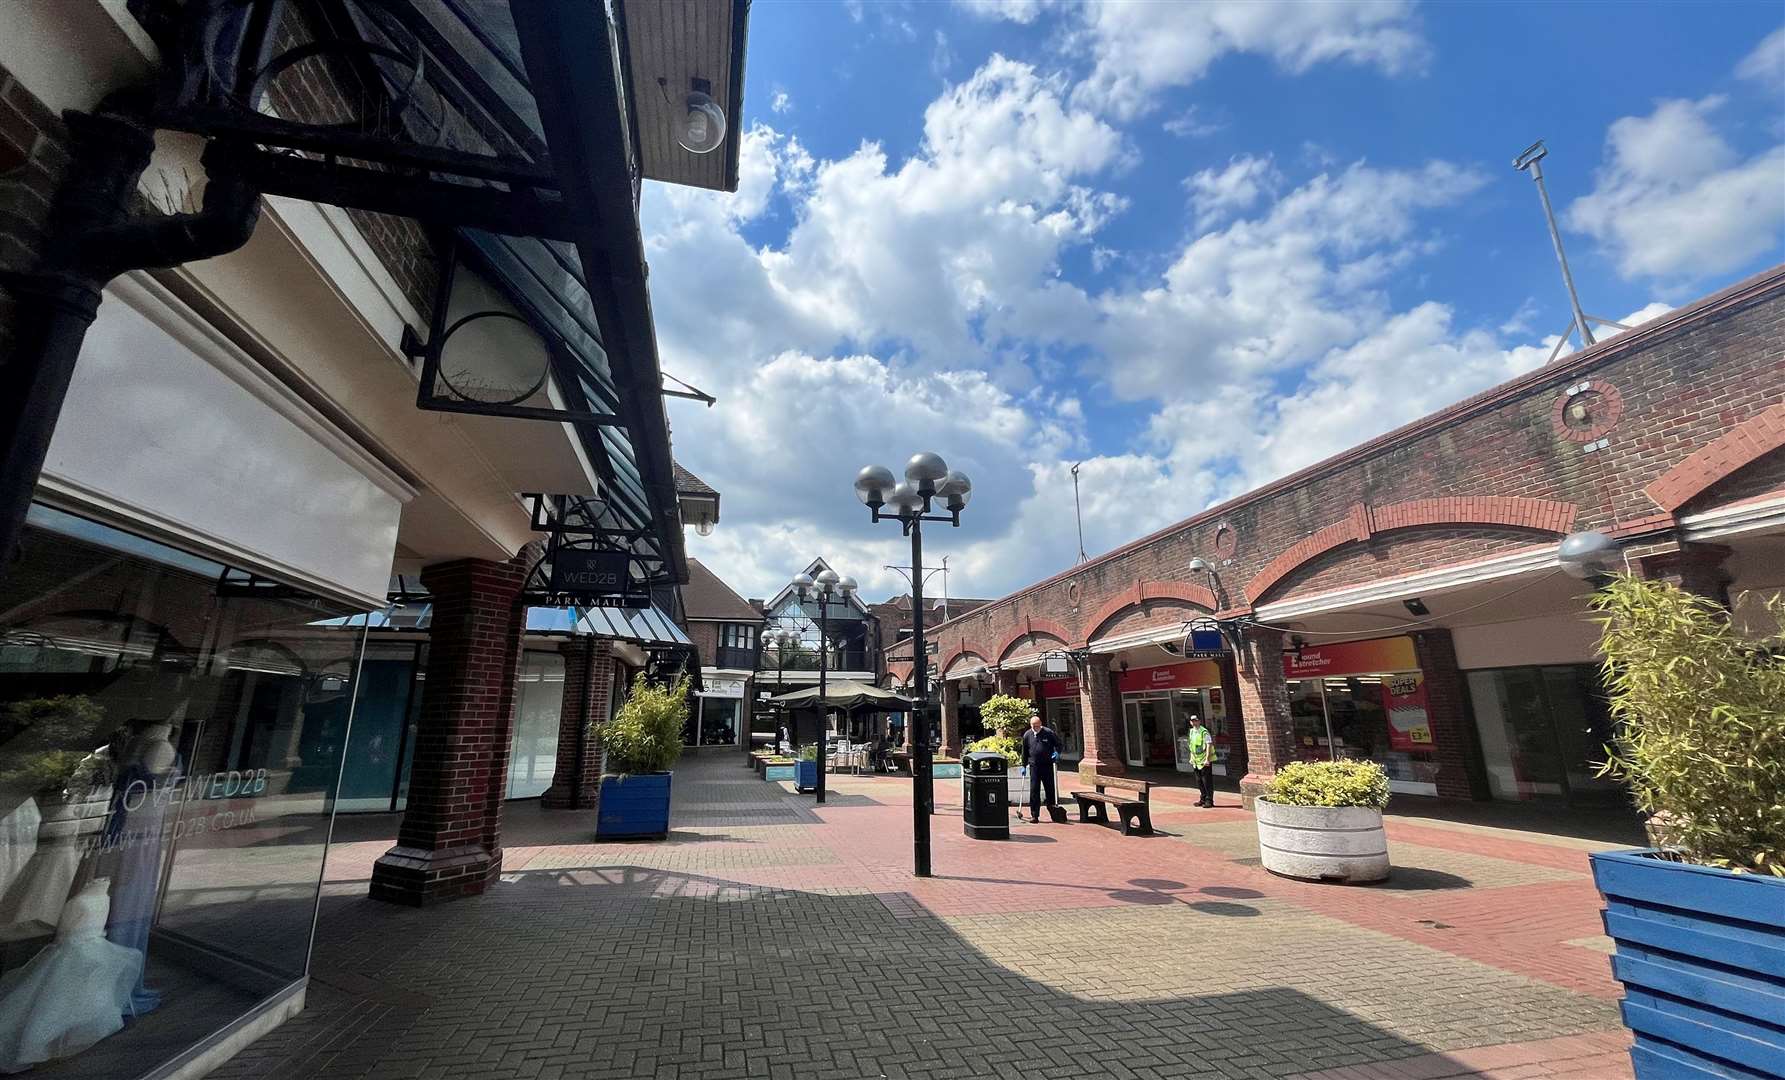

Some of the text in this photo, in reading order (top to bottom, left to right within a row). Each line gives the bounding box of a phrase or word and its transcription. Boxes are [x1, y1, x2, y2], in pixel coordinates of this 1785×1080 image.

[563, 571, 617, 585] WED2B
[545, 596, 629, 607] PARK MALL
